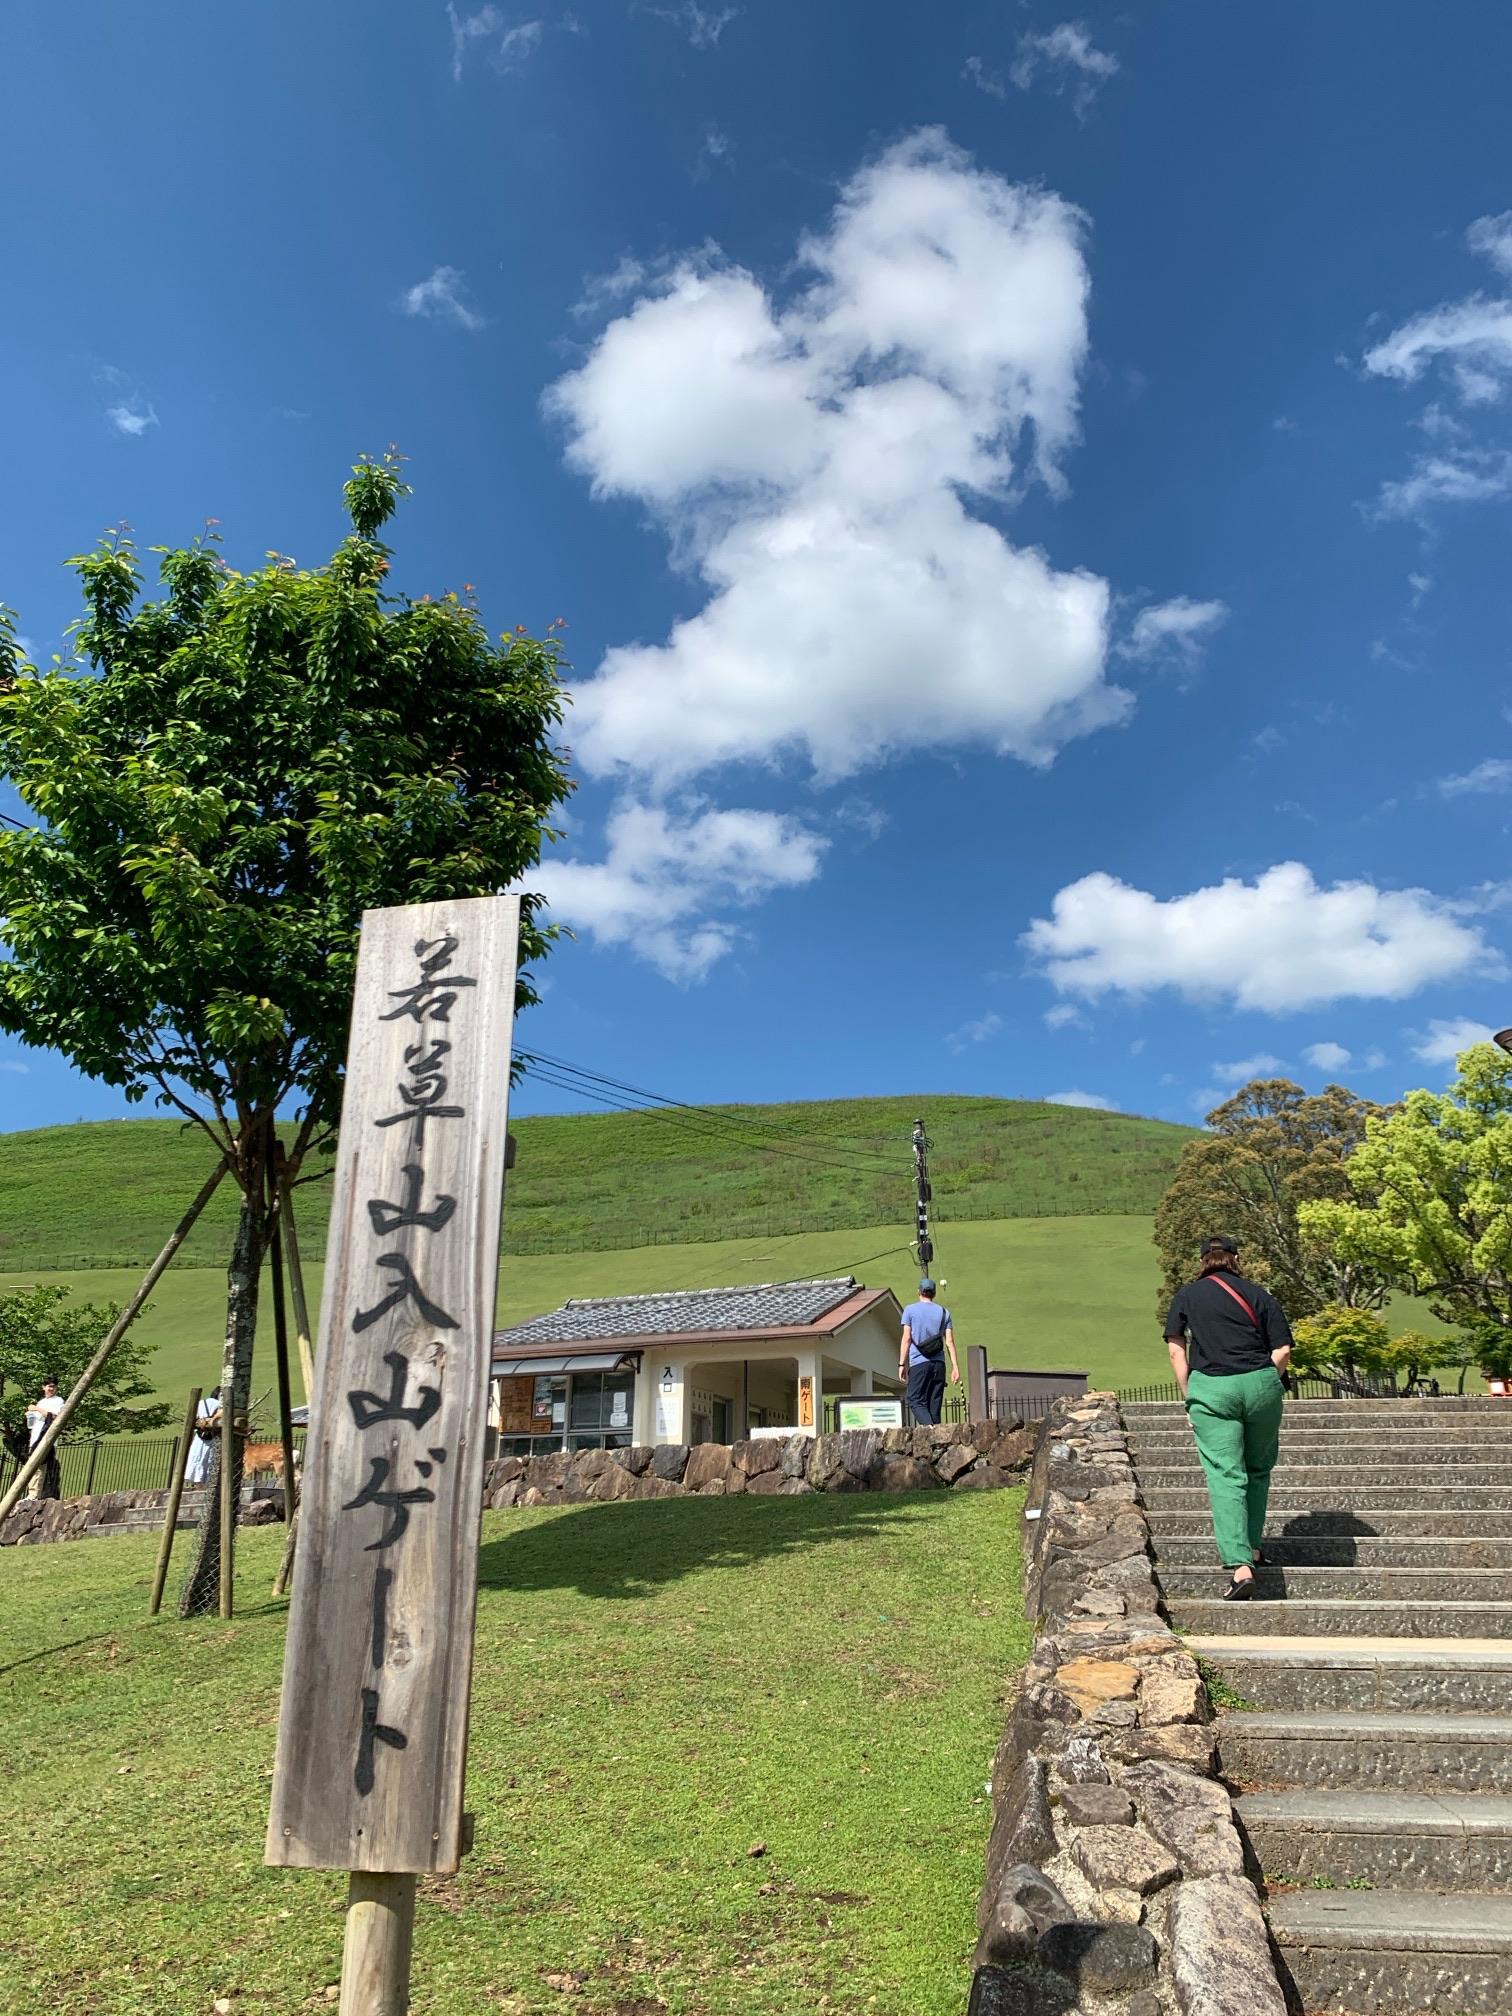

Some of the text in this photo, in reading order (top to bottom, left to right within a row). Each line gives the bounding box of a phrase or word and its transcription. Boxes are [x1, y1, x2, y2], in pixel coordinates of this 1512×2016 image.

[343, 936, 478, 1798] 若草山入山ゲート
[663, 1366, 673, 1393] 入口
[800, 1378, 811, 1424] 南ゲート
